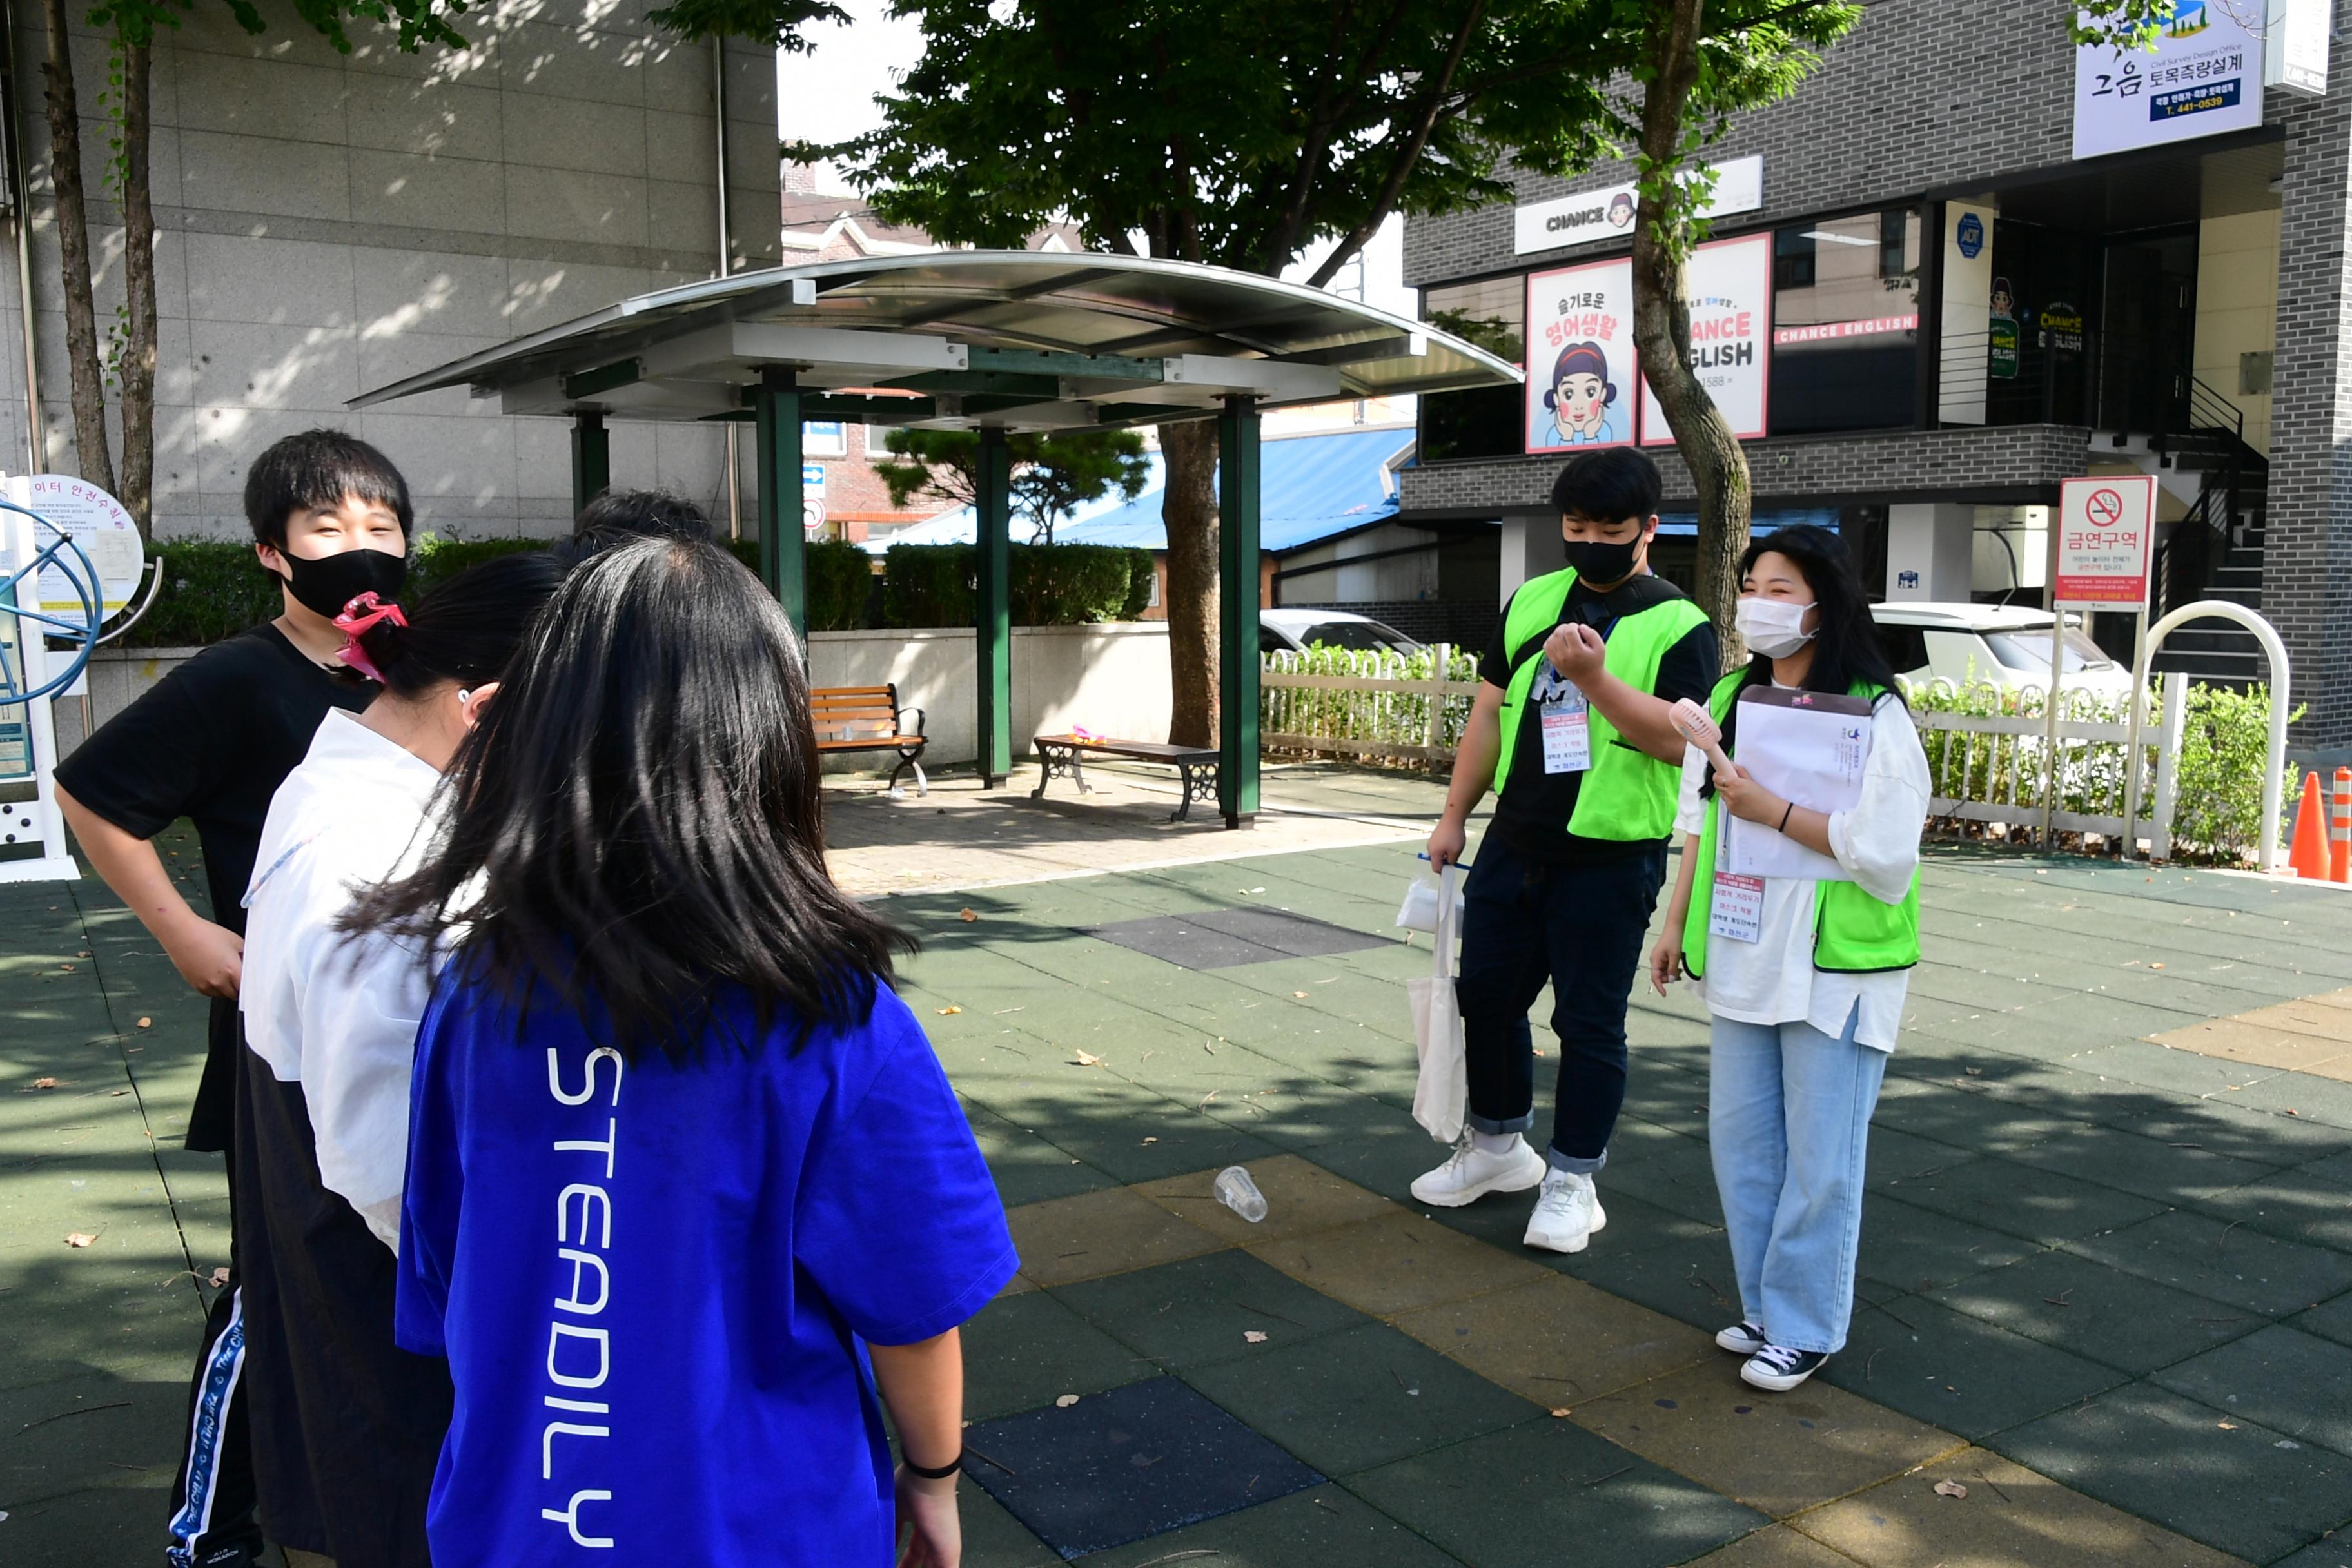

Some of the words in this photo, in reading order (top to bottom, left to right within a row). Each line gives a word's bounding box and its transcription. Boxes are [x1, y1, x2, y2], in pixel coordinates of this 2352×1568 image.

[2167, 55, 2191, 66] Survey
[2193, 49, 2218, 59] Design
[2219, 44, 2242, 54] Office
[2177, 96, 2223, 113] 441-0539
[1546, 206, 1604, 232] CHANCE
[1961, 228, 1979, 243] ADT
[1558, 292, 1605, 315] 슬기로운
[1546, 313, 1618, 347] 영어생활
[1780, 326, 1838, 342] CHANCE
[1845, 317, 1913, 335] ENGLISH
[2067, 531, 2137, 550] 금연구역
[541, 1046, 623, 1549] STEADILY
[206, 1549, 239, 1565] MONARCH
[213, 1548, 228, 1557] AIR
